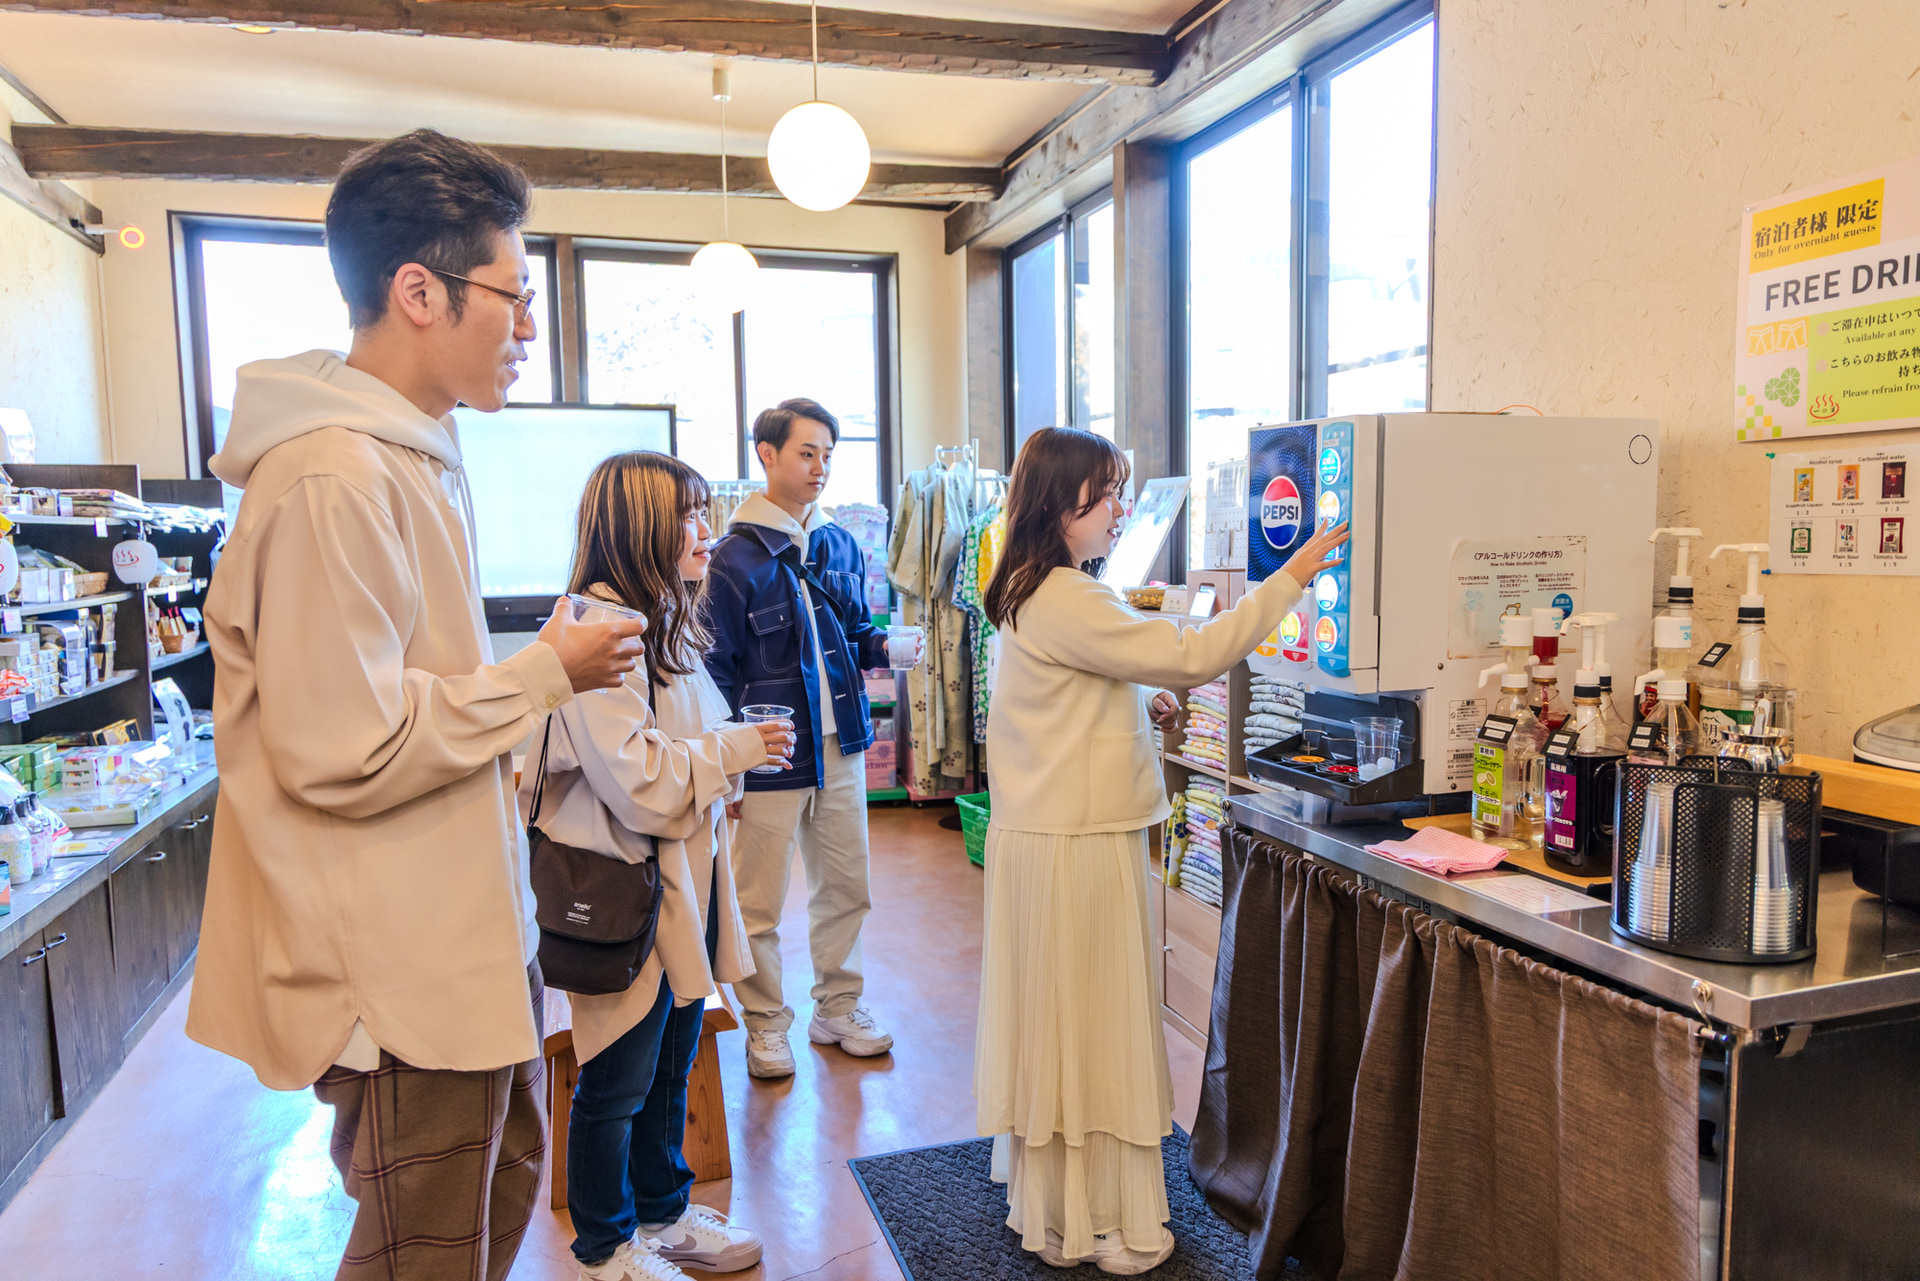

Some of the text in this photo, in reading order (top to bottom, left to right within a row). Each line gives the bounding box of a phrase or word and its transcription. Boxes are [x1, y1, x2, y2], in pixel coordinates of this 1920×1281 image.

[1755, 198, 1879, 248] 宿泊者様 限定
[1754, 224, 1876, 260] Only for overnight guests
[1766, 252, 1920, 312] FREE DRI
[1844, 330, 1885, 344] Available
[1900, 327, 1916, 336] any
[1842, 390, 1869, 398] Please
[1872, 384, 1903, 395] refrain
[1263, 504, 1298, 520] PEPSI
